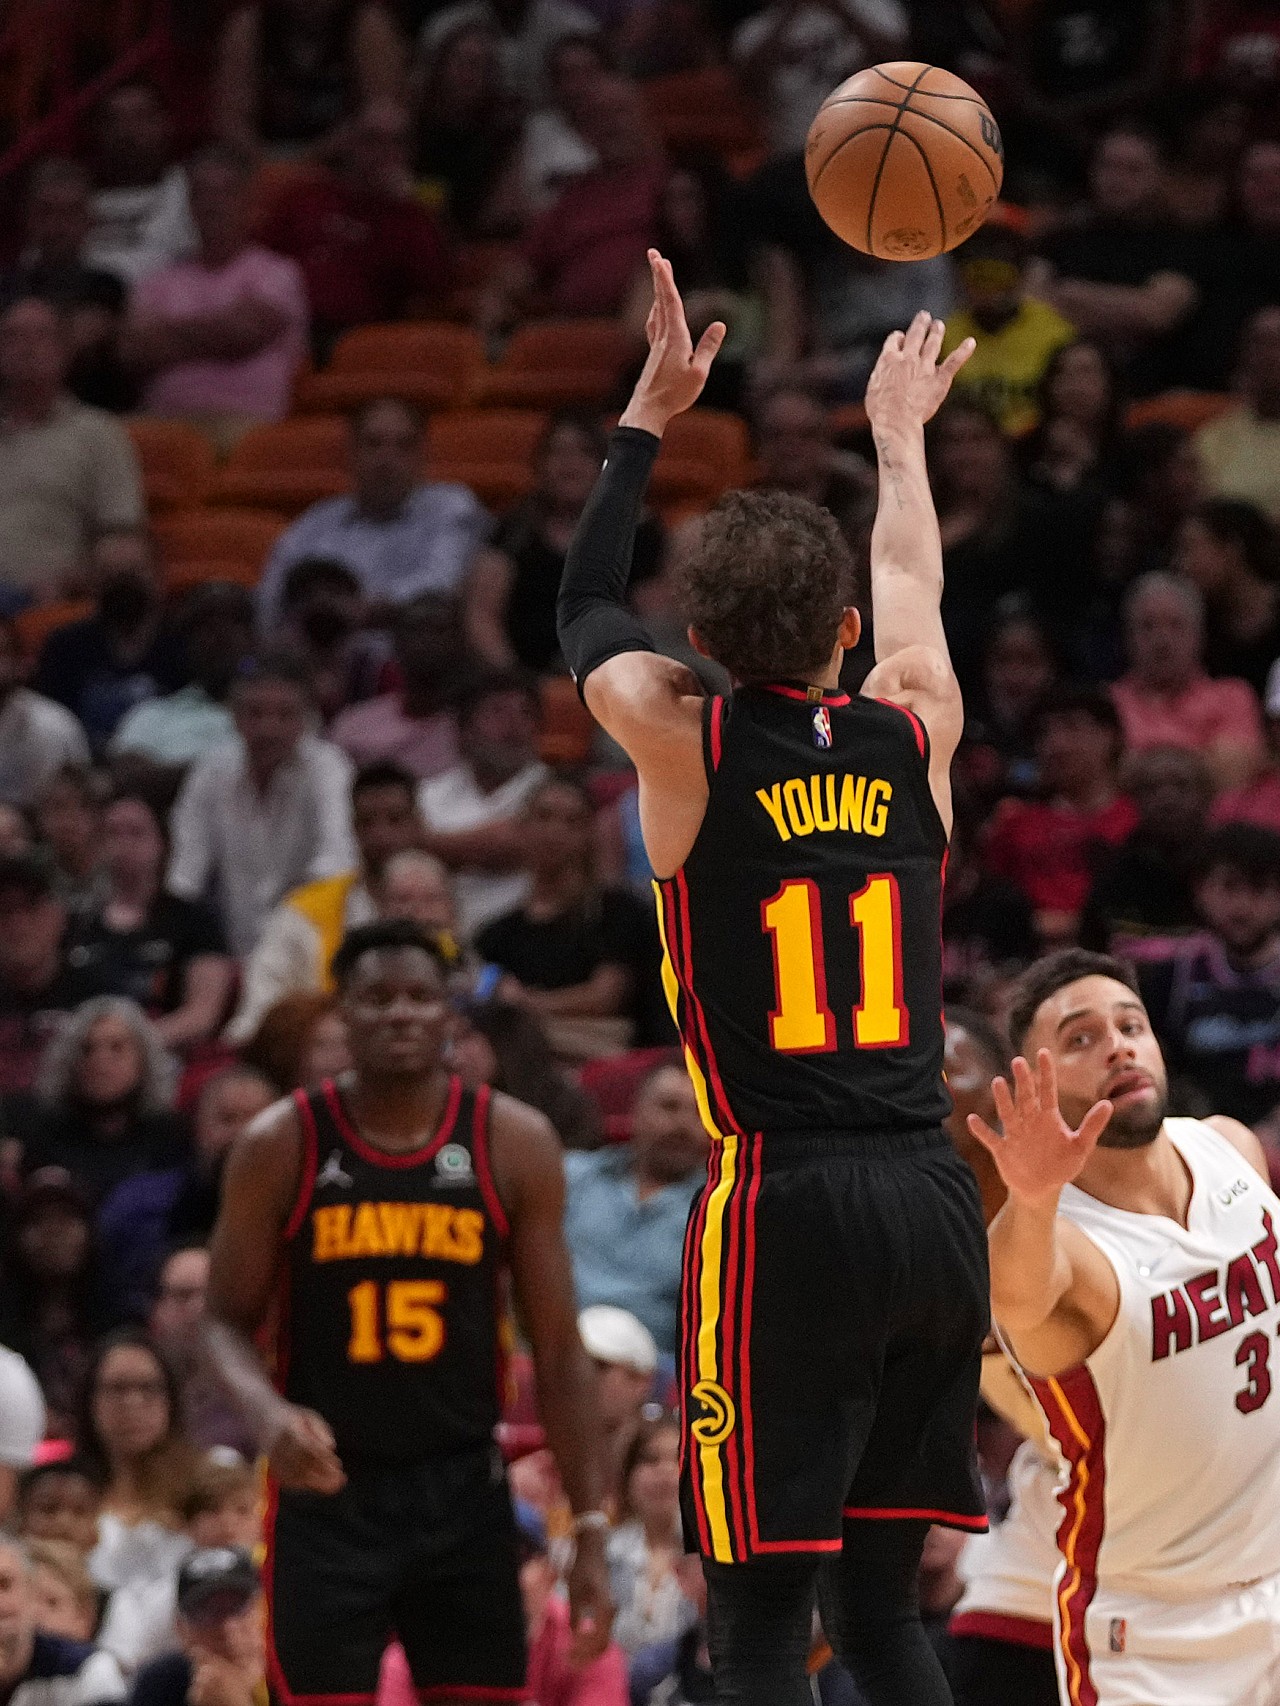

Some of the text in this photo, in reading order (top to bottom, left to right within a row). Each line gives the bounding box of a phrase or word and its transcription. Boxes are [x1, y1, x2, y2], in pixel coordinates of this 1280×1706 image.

[755, 773, 893, 842] YOUNG
[760, 872, 910, 1055] 11
[312, 1202, 486, 1267] HAWKS
[347, 1279, 447, 1364] 15
